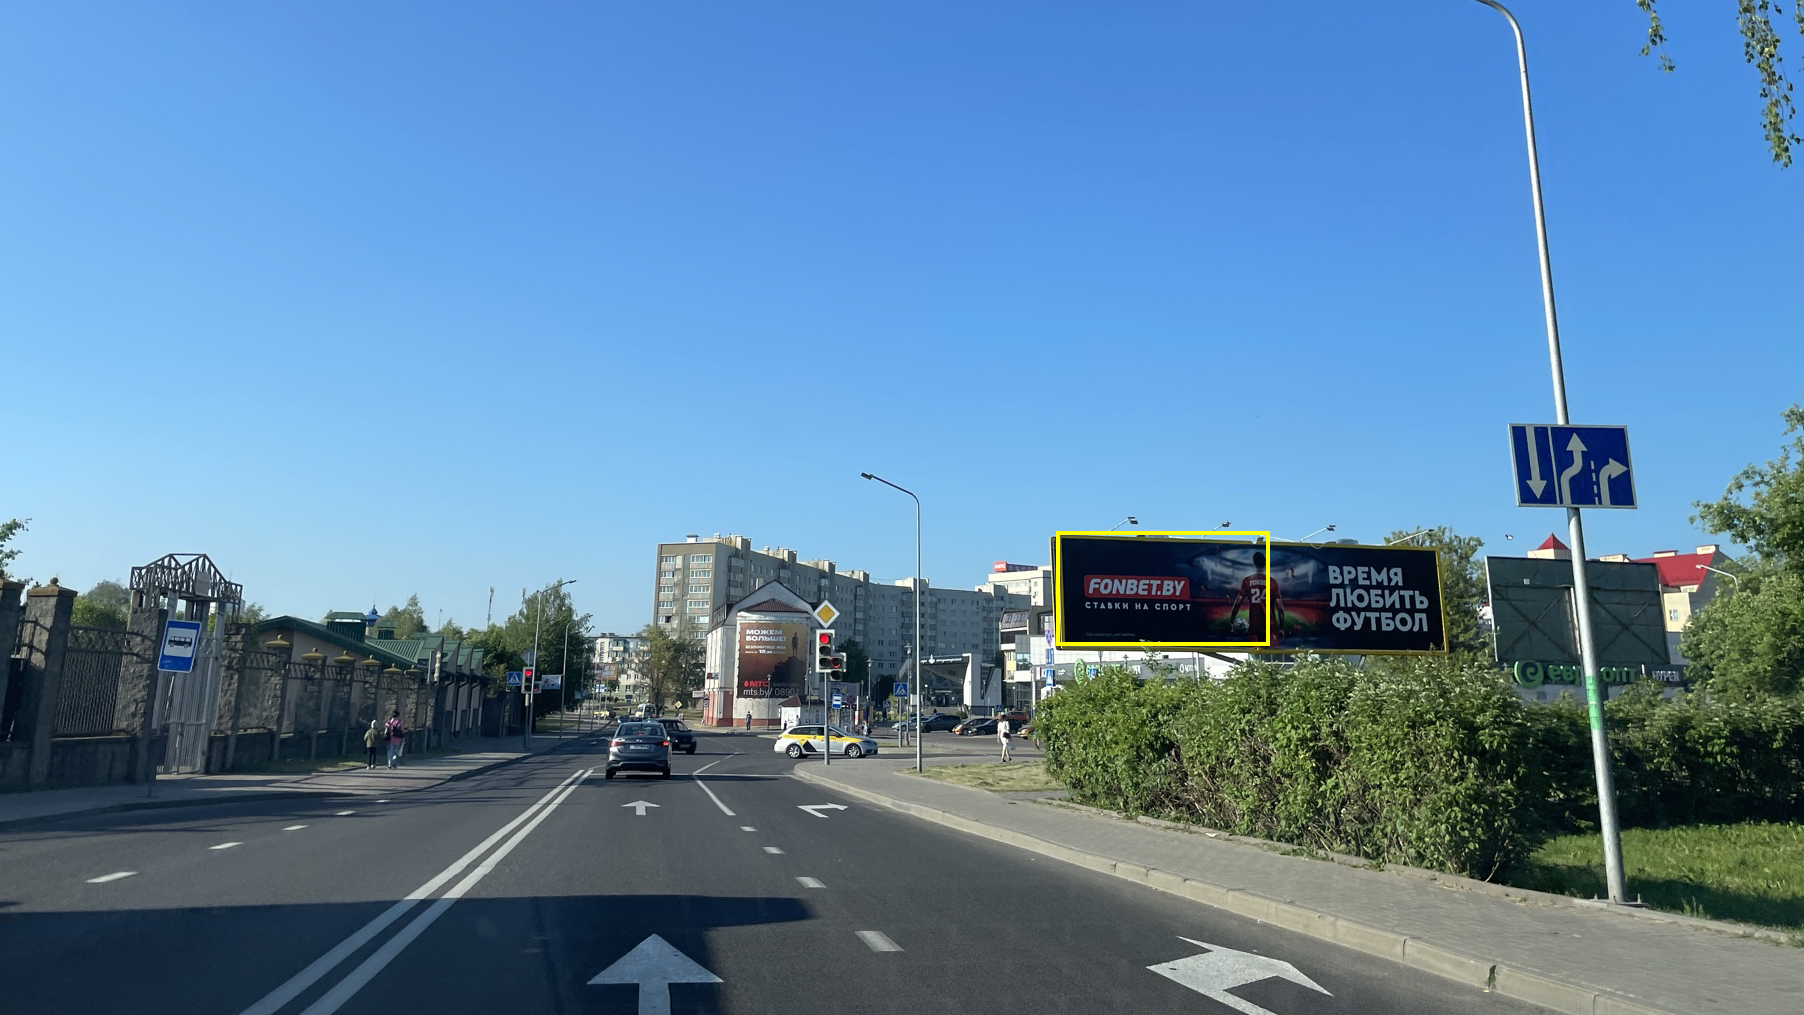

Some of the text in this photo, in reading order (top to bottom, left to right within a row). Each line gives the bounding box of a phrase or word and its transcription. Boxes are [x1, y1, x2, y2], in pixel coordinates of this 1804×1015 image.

[1327, 565, 1404, 587] ВРЕМЯ
[1088, 578, 1185, 596] FONBET.BY
[1085, 602, 1129, 610] СТАВКИ
[1154, 603, 1191, 611] СПОРТ
[1329, 588, 1429, 609] ЛЮБИТЬ
[1331, 610, 1429, 632] ФУТБОЛ
[1651, 670, 1680, 681] HYPER
